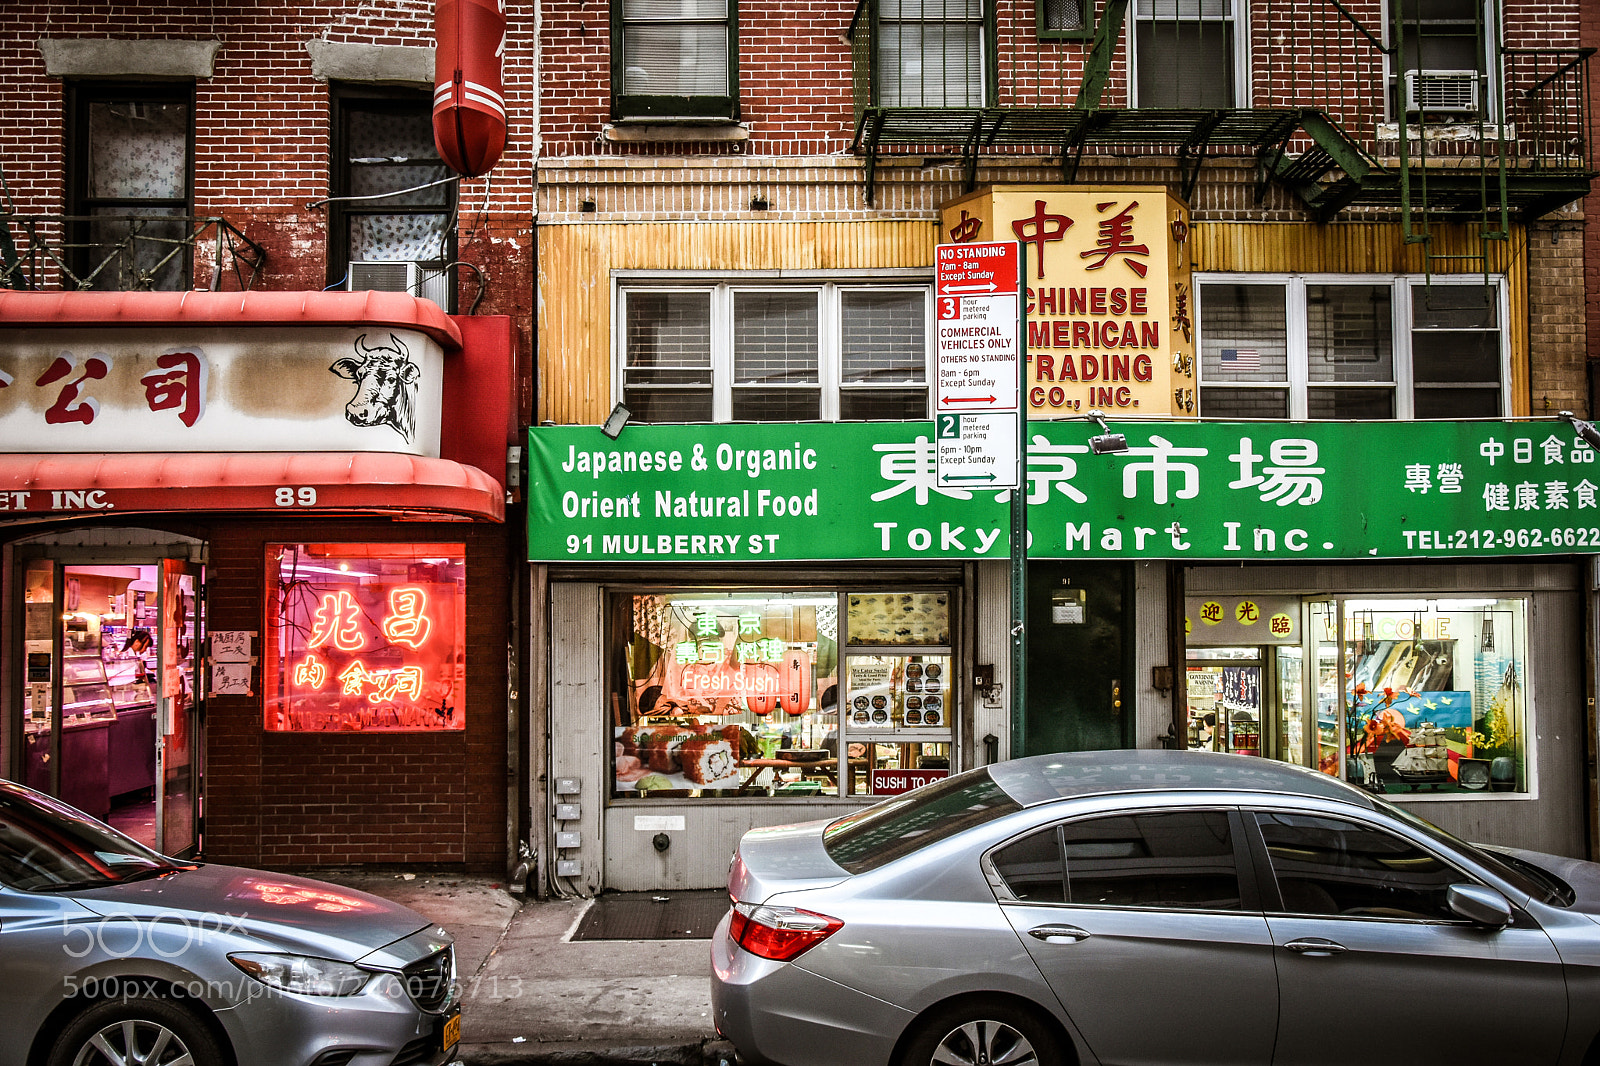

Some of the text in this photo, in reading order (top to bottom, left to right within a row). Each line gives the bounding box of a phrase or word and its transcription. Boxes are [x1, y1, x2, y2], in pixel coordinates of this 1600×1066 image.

[1011, 200, 1150, 279] 中美
[940, 246, 1006, 259] NO STANDING
[940, 262, 957, 271] 7am
[962, 261, 979, 270] 8am
[940, 270, 994, 281] Except Sunday
[942, 298, 956, 318] 3
[962, 312, 987, 320] parking
[941, 326, 1002, 338] COMMERCIAL
[1026, 320, 1159, 348] MERICAN
[941, 338, 1012, 350] VEHICLES ONLY
[940, 355, 968, 363] OTHERS
[981, 354, 1016, 362] STANDING
[940, 369, 957, 377] 8am
[963, 369, 980, 378] 6pm
[940, 378, 996, 388] Except Sunday
[1029, 386, 1139, 411] CO., INC.
[942, 416, 955, 437] 2
[962, 432, 987, 440] parking
[940, 446, 957, 455] 6pm
[963, 445, 982, 455] 10pm
[940, 455, 996, 465] Except Sunday
[1479, 434, 1596, 466] 中日食品
[562, 442, 817, 479] Japanese & Organic
[870, 435, 1326, 506] 東京市場
[1404, 463, 1464, 494] 專營
[51, 490, 115, 509] INC.
[274, 487, 317, 507] 89
[562, 488, 818, 518] Orient Natural Food
[1482, 479, 1599, 512] 健康素食
[566, 534, 780, 554] 91 MULBERRY ST
[1065, 522, 1191, 552] Mart
[1222, 522, 1335, 552] Inc.
[695, 613, 762, 636] 東京
[683, 670, 780, 692] Fresh Sushi
[875, 777, 907, 789] SUSHI
[910, 777, 926, 789] TO
